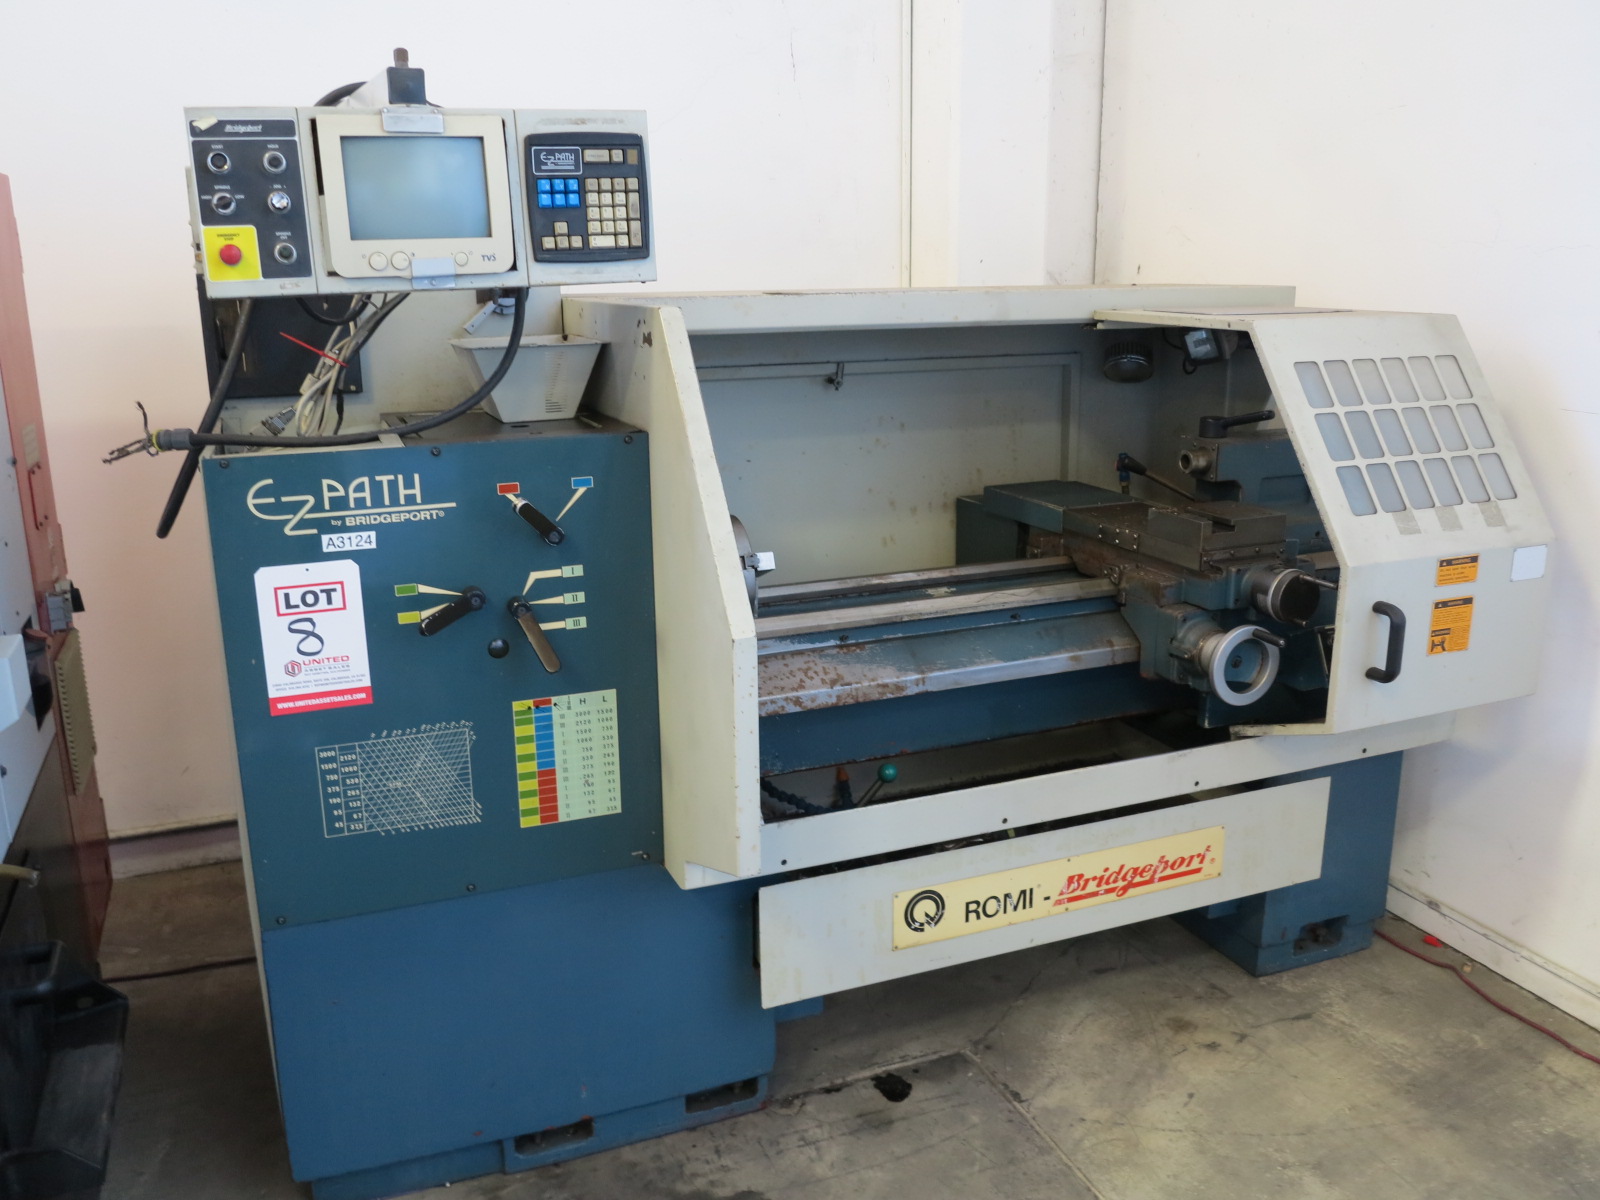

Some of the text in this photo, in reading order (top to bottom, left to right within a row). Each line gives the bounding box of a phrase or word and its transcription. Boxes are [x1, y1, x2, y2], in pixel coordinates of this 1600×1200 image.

[321, 473, 422, 510] PATH
[331, 519, 342, 527] by
[325, 534, 373, 550] A3124
[283, 588, 337, 610] LOT
[287, 617, 324, 657] 8
[302, 655, 350, 666] UNITED
[964, 887, 1034, 923] ROMI
